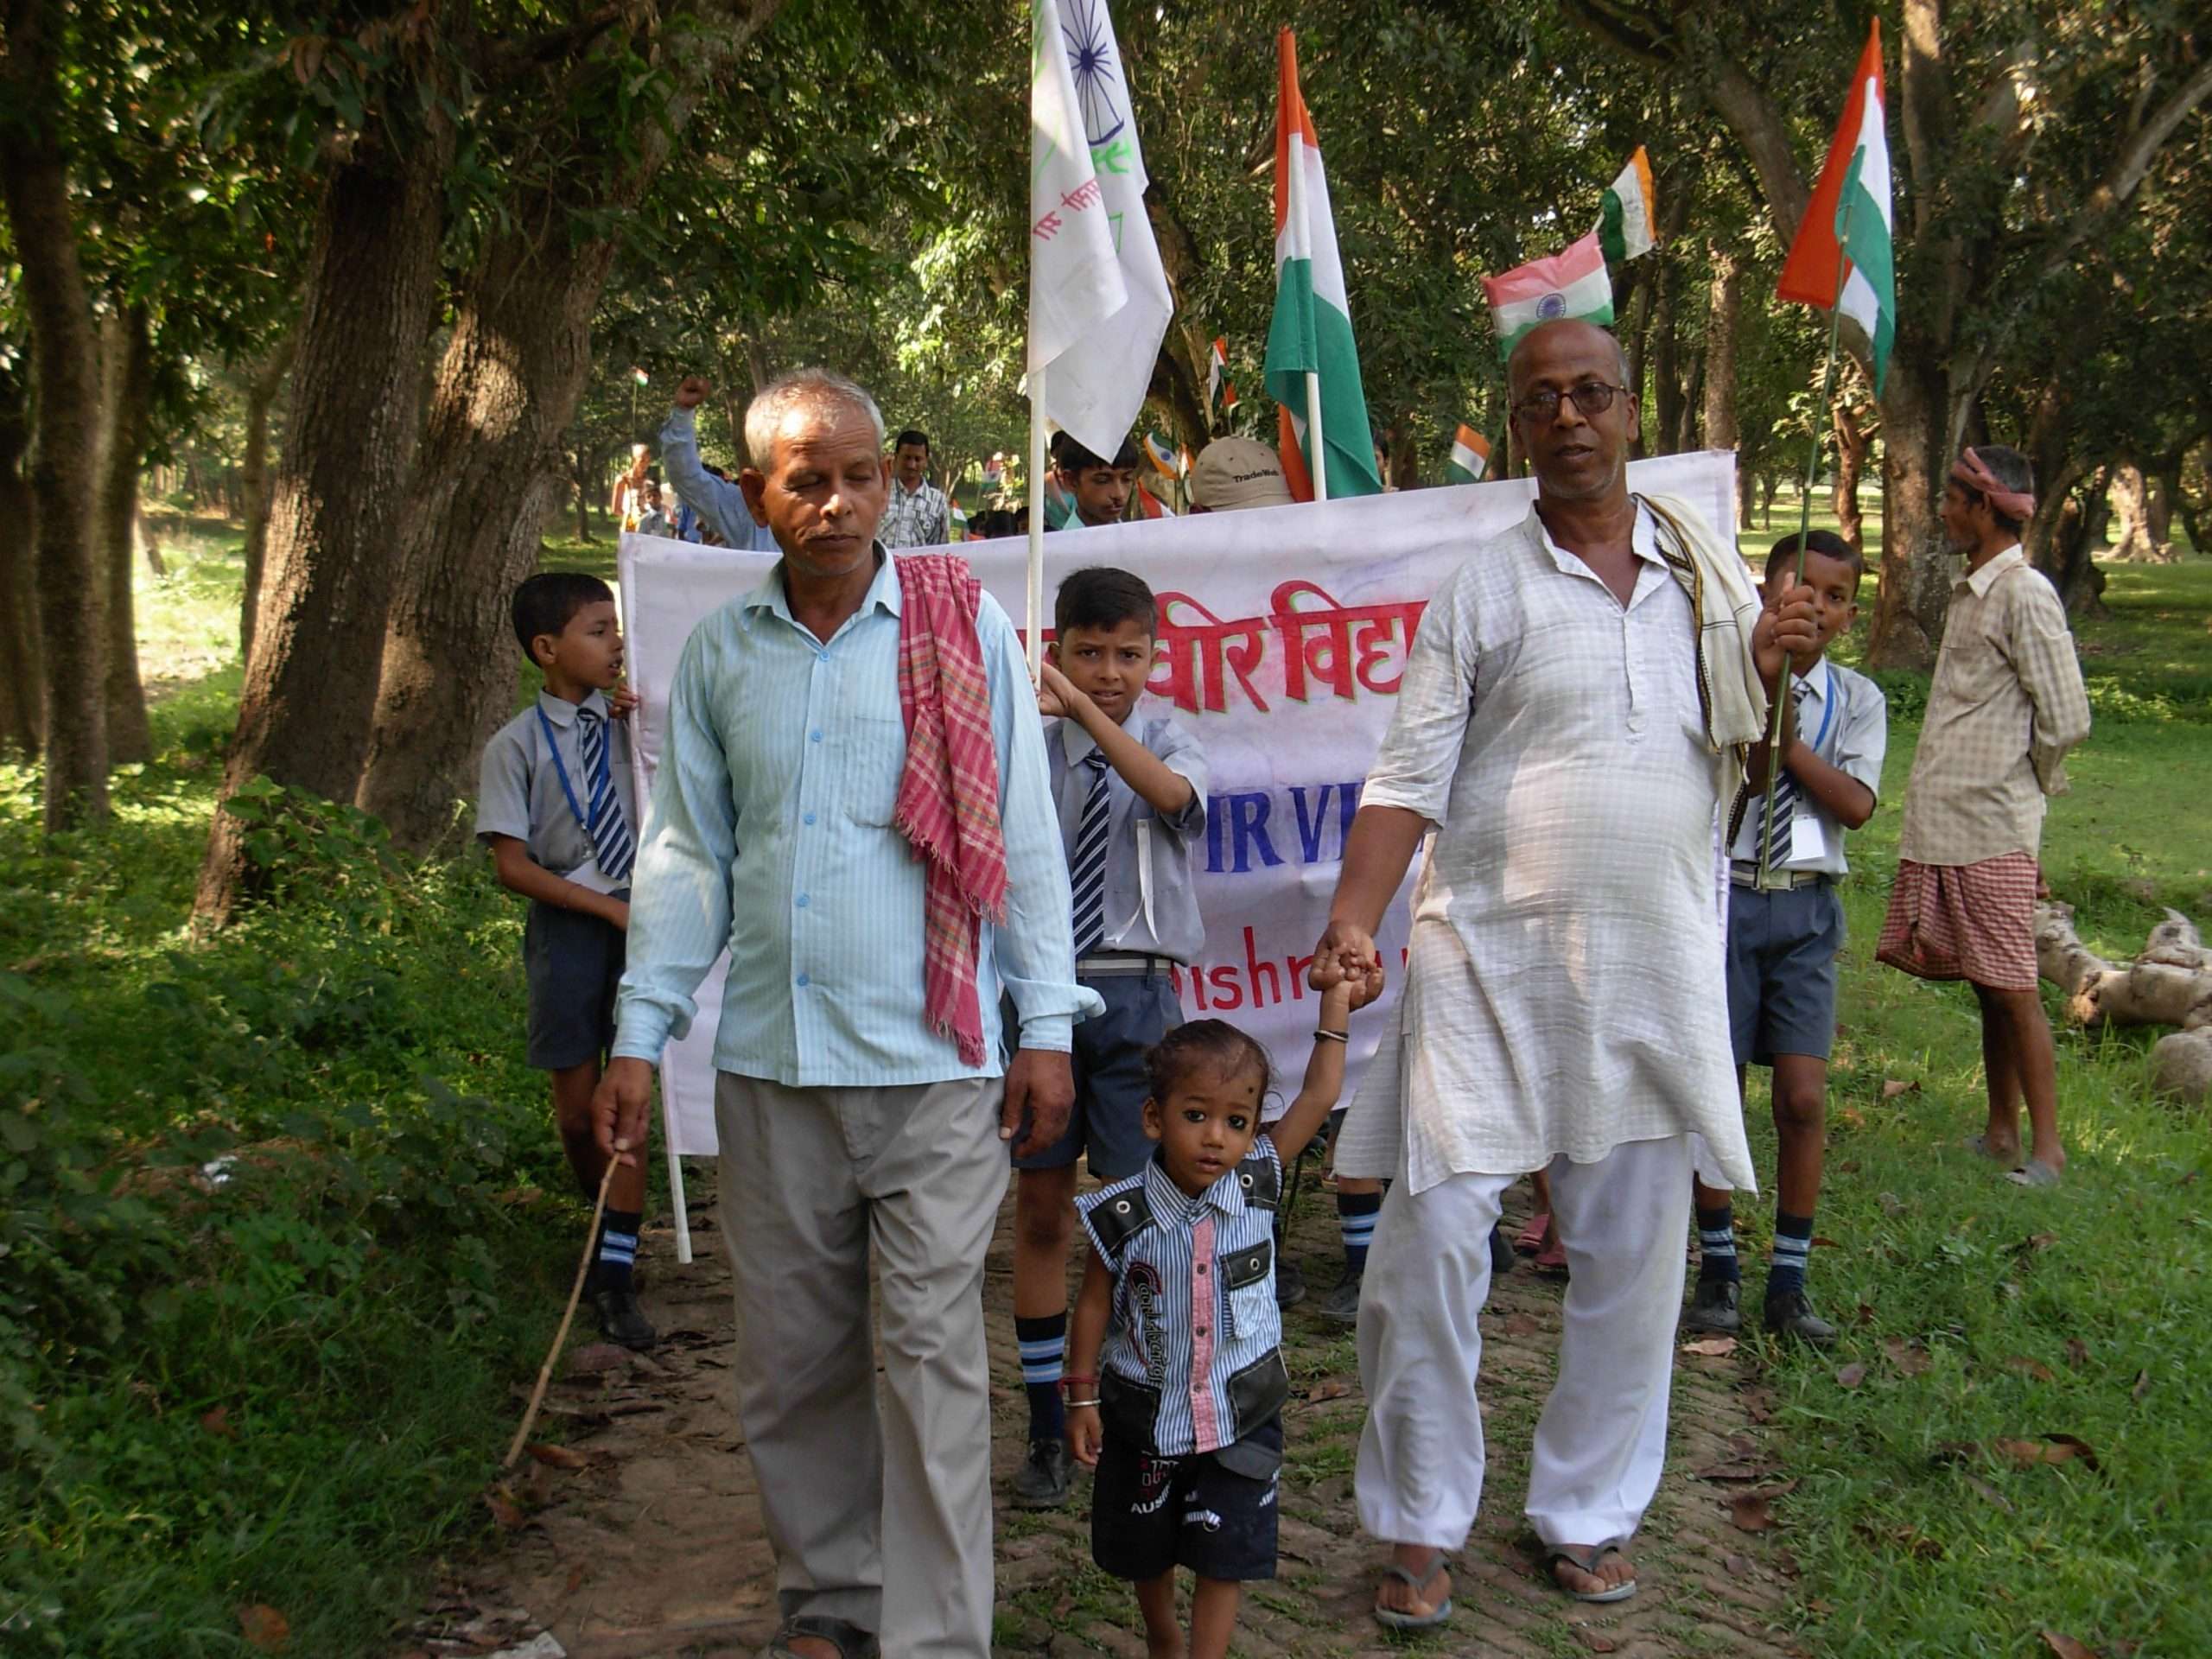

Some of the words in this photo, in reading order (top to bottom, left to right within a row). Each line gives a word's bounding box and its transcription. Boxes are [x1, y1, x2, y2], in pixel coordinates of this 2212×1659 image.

[1145, 591, 1271, 713] वीर
[1205, 791, 1286, 873] IR
[1169, 926, 1322, 1011] ishn
